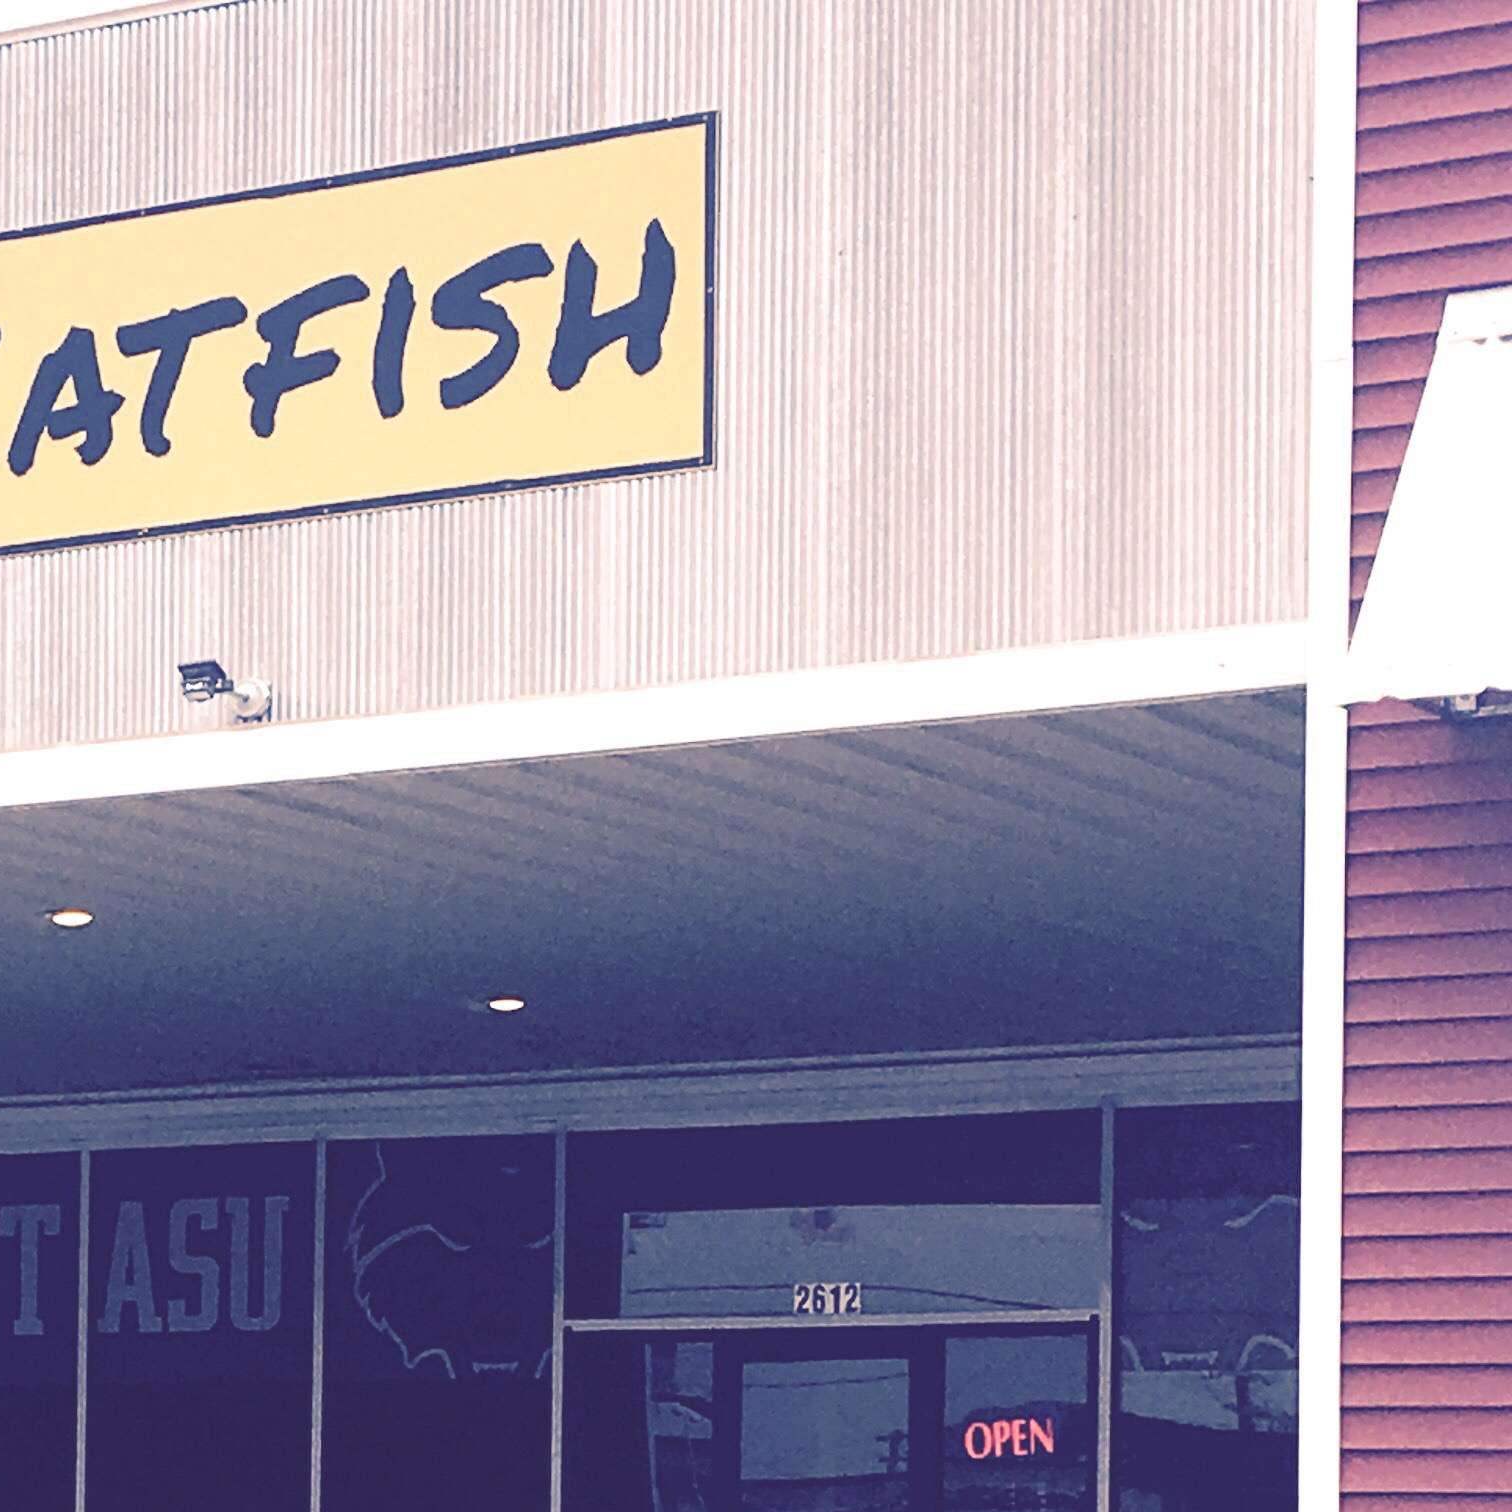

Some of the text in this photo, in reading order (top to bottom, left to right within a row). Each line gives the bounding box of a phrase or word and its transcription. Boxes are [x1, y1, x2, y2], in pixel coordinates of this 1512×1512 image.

[97, 1196, 290, 1336] ASU
[795, 1284, 859, 1314] 2612
[964, 1417, 1054, 1460] OPEN
